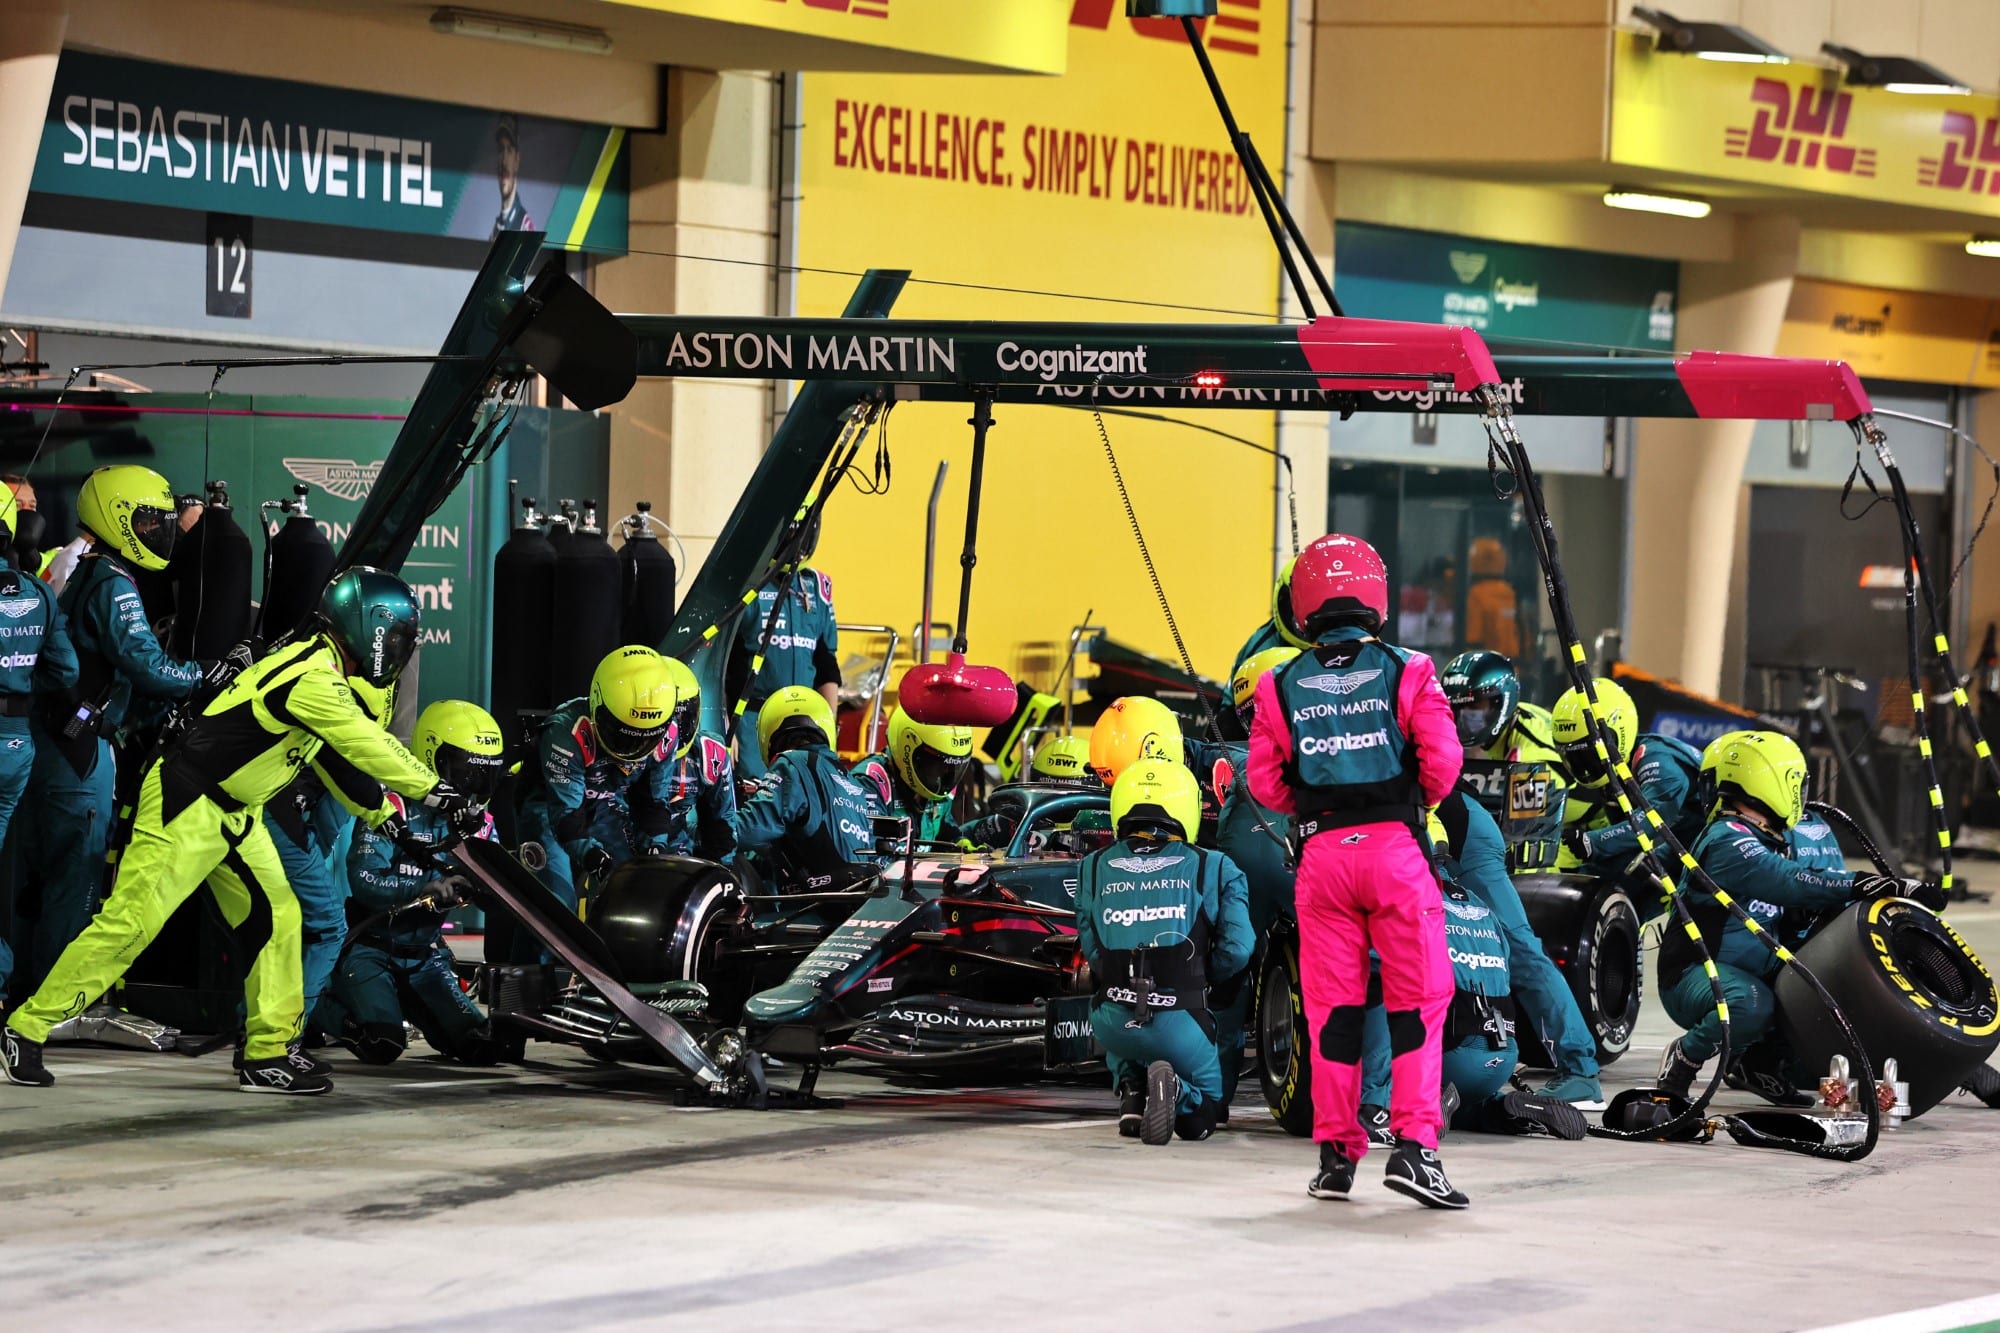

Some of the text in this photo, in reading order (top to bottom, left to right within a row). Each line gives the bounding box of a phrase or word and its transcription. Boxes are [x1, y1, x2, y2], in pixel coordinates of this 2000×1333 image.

[1746, 76, 1857, 174] DHL
[63, 95, 443, 207] SEBASTIAN VETTEL
[833, 98, 1013, 188] EXCELLENCE.
[1022, 124, 1118, 200] SIMPLY
[214, 237, 247, 294] 12
[666, 331, 955, 373] ASTON MARTIN
[996, 340, 1148, 381] Cognizant
[328, 468, 360, 480] ASTON
[118, 514, 145, 562] Cognizant
[120, 600, 140, 612] EPOS
[372, 626, 385, 678] Cognizant
[639, 709, 663, 720] BWT
[1292, 698, 1389, 724] ASTON MARTIN
[618, 728, 666, 737] ASTON MARTIN
[1558, 721, 1577, 732] BWT
[383, 737, 411, 764] ASTON
[1300, 728, 1390, 757] Cognizant
[467, 758, 489, 766] ASTON
[903, 744, 917, 789] Cognizant
[943, 757, 962, 766] ASTON
[1055, 758, 1078, 769] BWT
[1058, 778, 1083, 786] MARTIN
[1512, 780, 1547, 810] JCB
[1140, 878, 1190, 890] MARTIN
[1794, 872, 1823, 886] ASTON
[722, 882, 734, 897] P
[843, 919, 901, 929] BWT
[1103, 903, 1187, 927] Cognizant
[1444, 924, 1472, 937] STON
[831, 942, 873, 951] NetApp
[806, 969, 832, 979] IFS
[1588, 920, 1601, 1012] ZERO
[1869, 932, 1959, 1029] P ZERO
[888, 1009, 1046, 1028] ASTON MARTIN
[1053, 1021, 1079, 1039] ASTON
